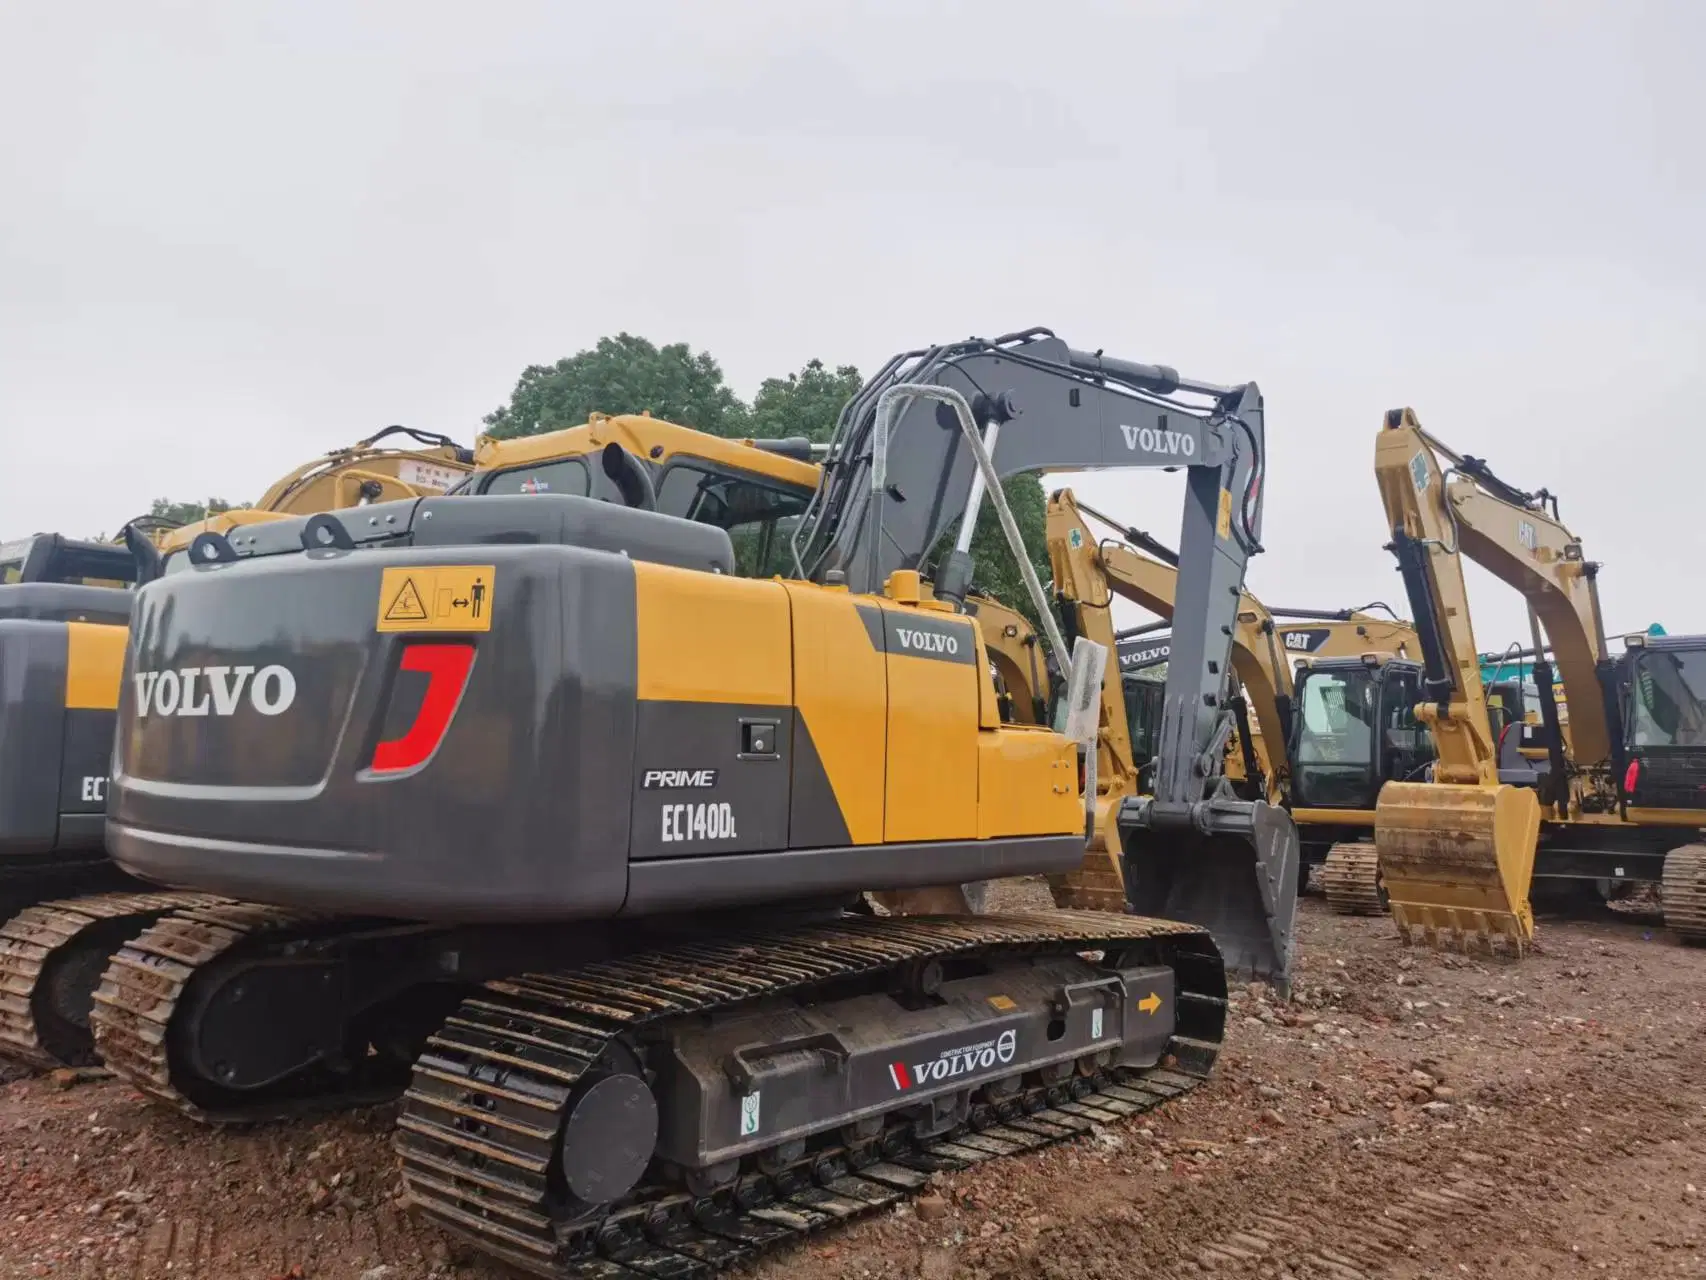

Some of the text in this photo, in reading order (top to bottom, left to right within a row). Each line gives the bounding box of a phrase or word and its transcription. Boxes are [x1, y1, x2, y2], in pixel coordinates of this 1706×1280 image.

[1119, 424, 1195, 457] VOLVO
[895, 628, 958, 655] VOLVO
[1285, 632, 1311, 650] CAT
[1120, 646, 1170, 665] VOLVO
[135, 664, 297, 717] VOLVO
[81, 776, 110, 801] EC
[643, 770, 716, 788] PRIME
[913, 1047, 996, 1084] VOLVO
